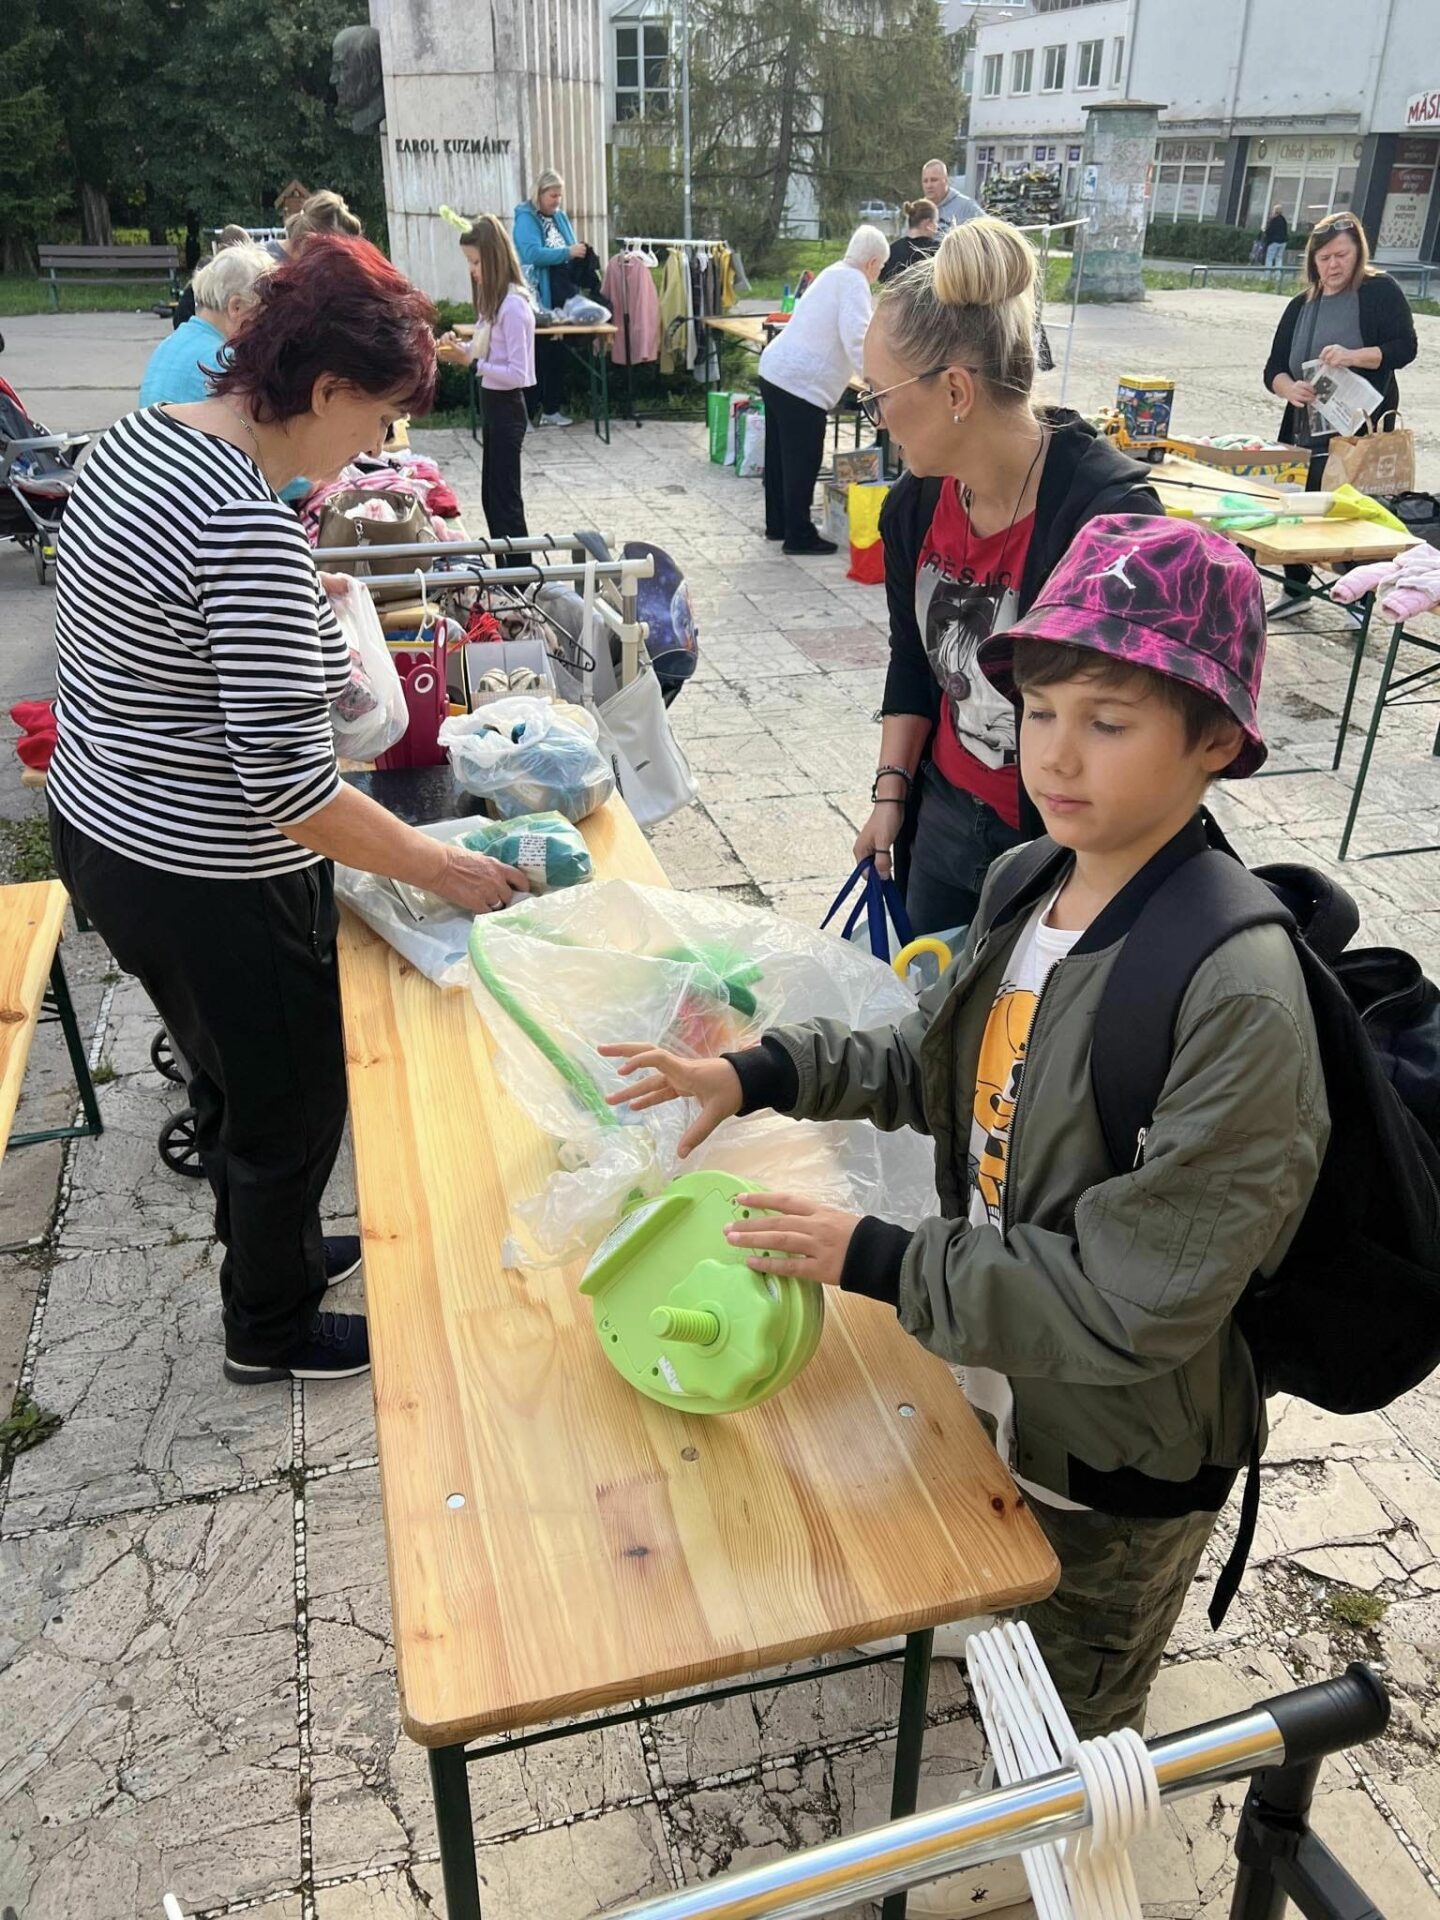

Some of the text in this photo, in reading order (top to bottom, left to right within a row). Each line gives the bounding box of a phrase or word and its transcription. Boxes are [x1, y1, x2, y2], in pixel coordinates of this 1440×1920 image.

[1407, 92, 1440, 123] MÄSI
[395, 136, 511, 155] KAROL KUZMÁNY
[923, 549, 976, 587] RÈS
